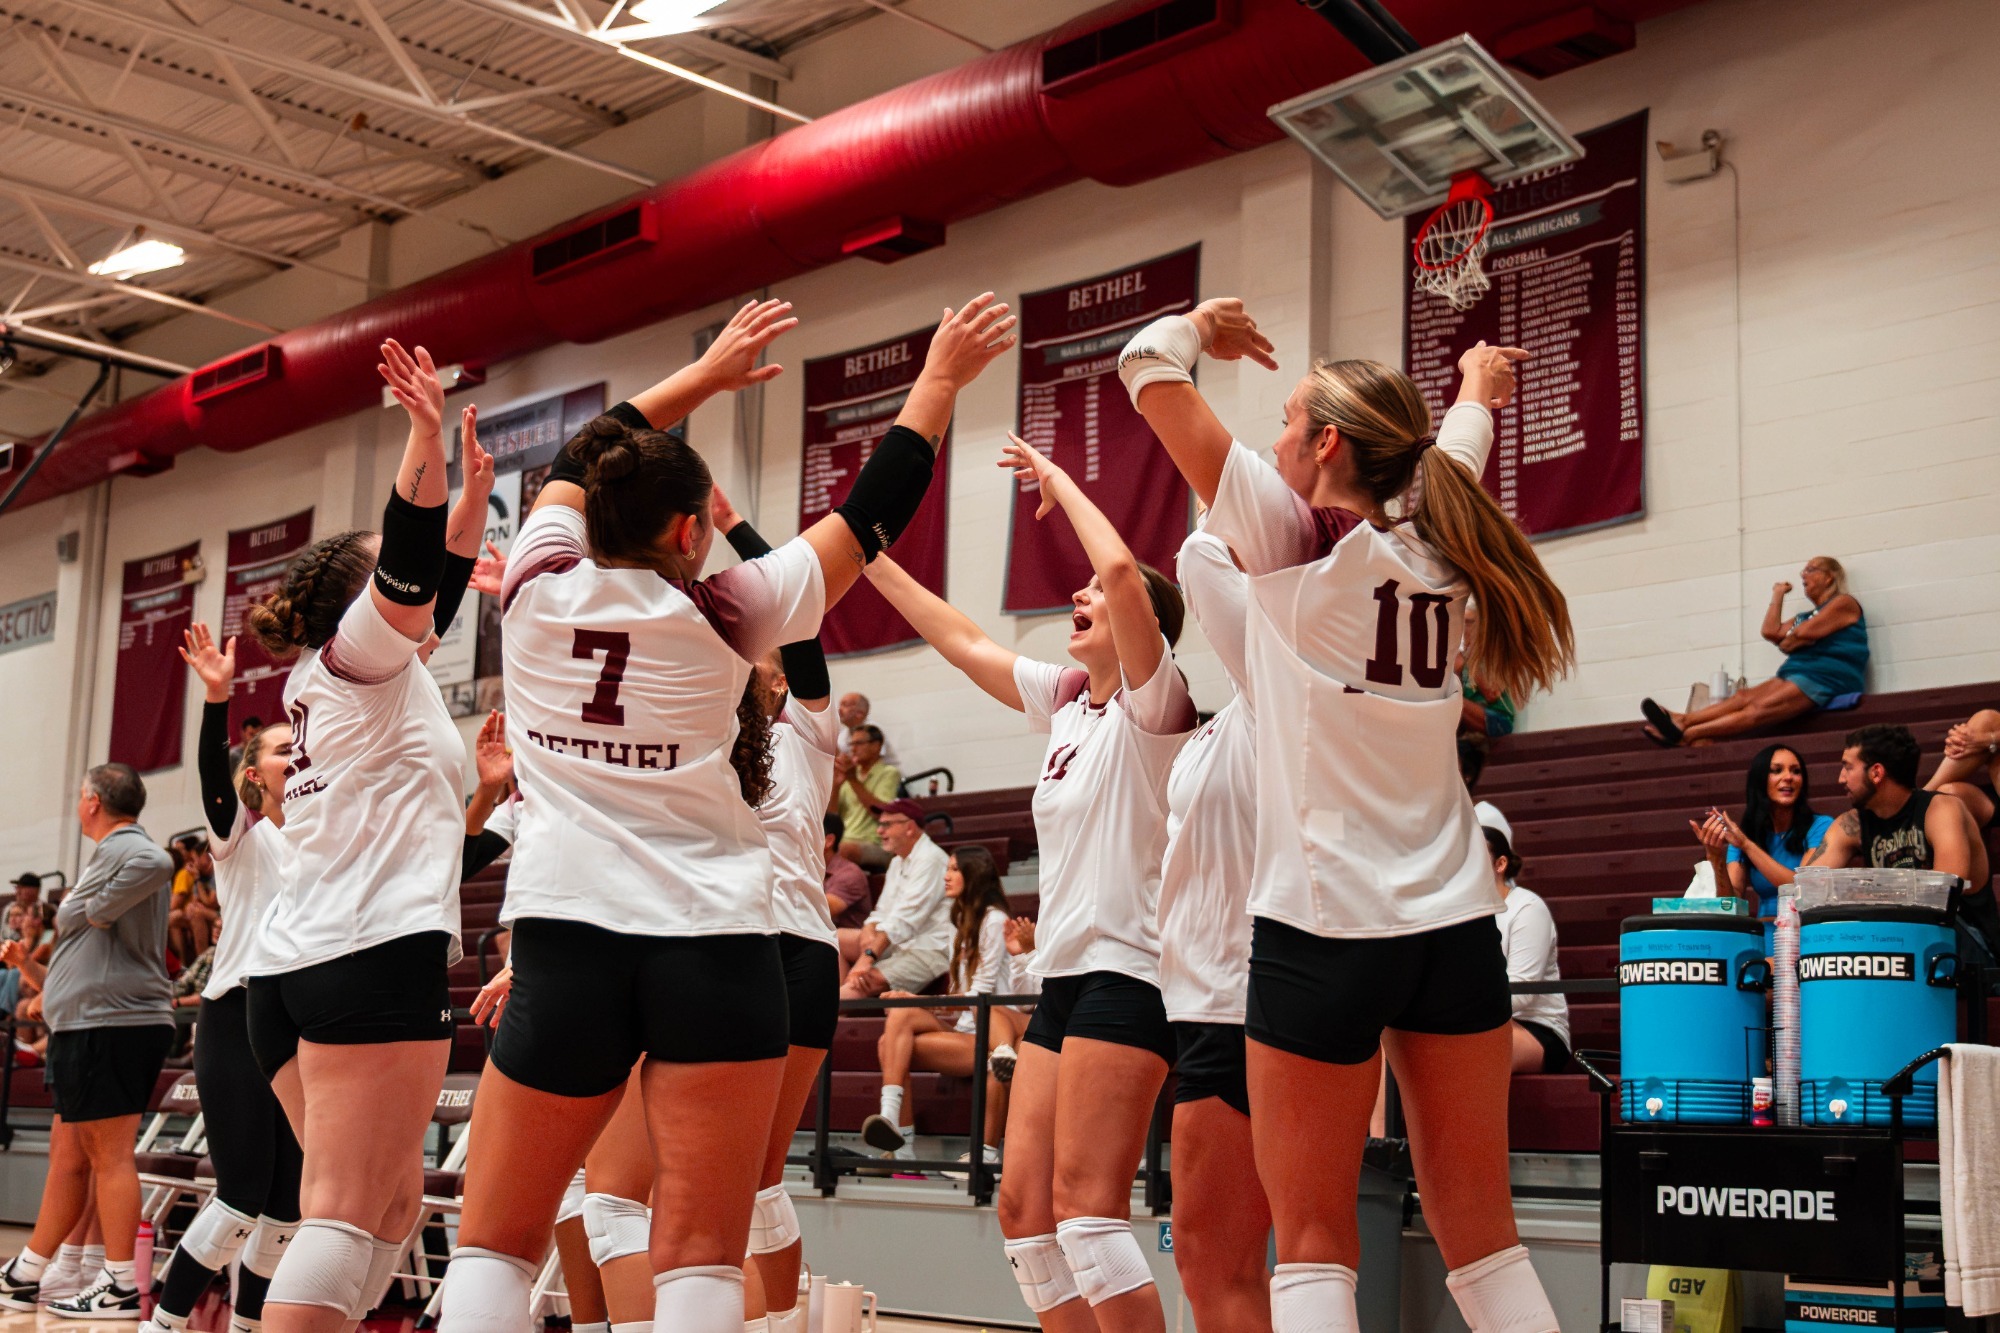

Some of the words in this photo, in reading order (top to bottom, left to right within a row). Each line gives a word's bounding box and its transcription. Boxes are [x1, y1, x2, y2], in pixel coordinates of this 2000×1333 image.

[1492, 212, 1580, 247] ALL-AMERICANS
[1493, 247, 1547, 271] FOOTBALL
[1068, 271, 1146, 312] BETHEL
[1066, 300, 1144, 332] COLLEGE
[845, 341, 913, 378] BETHEL
[1366, 578, 1454, 688] 10
[572, 628, 630, 727] 7
[436, 1089, 473, 1107] ETHEL
[1657, 1185, 1836, 1221] POWERADE
[1668, 1277, 1706, 1295] AED
[1800, 1305, 1878, 1324] POWERADE
